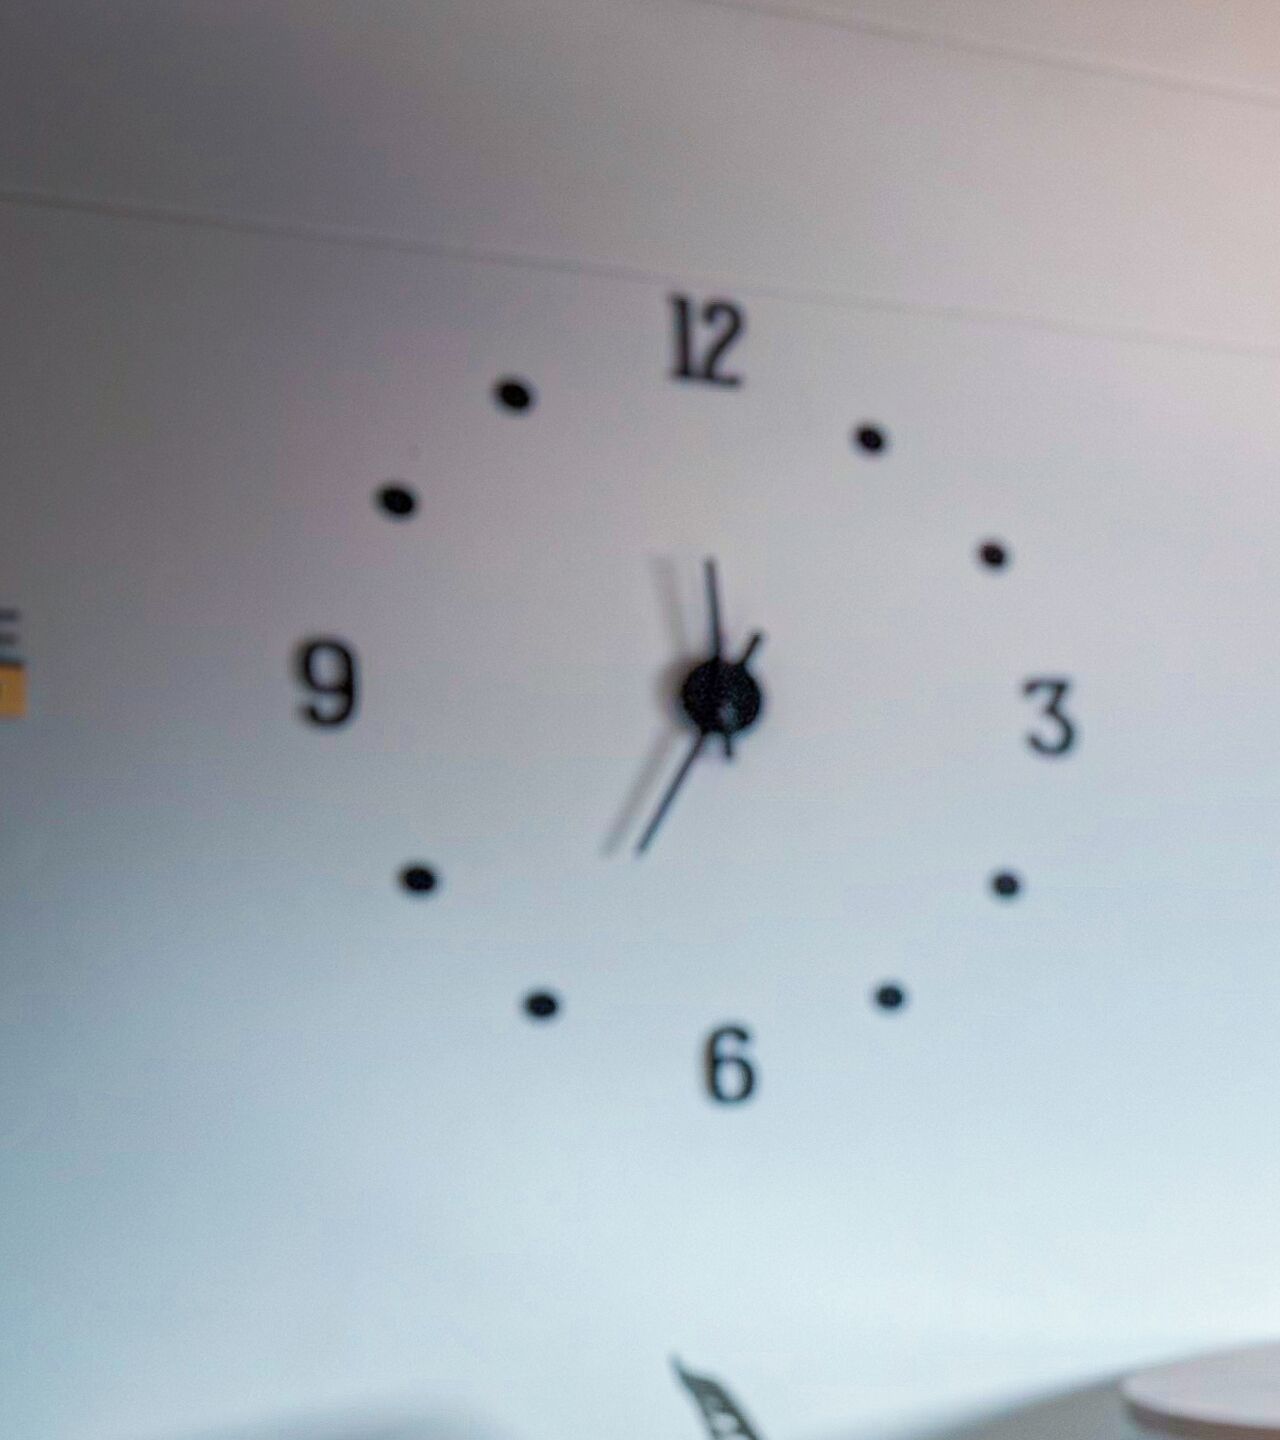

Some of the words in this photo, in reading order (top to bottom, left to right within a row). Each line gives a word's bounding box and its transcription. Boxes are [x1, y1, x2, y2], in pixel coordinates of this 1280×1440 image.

[668, 293, 744, 389] 12
[293, 636, 359, 730] 9
[1022, 677, 1077, 758] 3
[703, 1024, 757, 1104] 6
